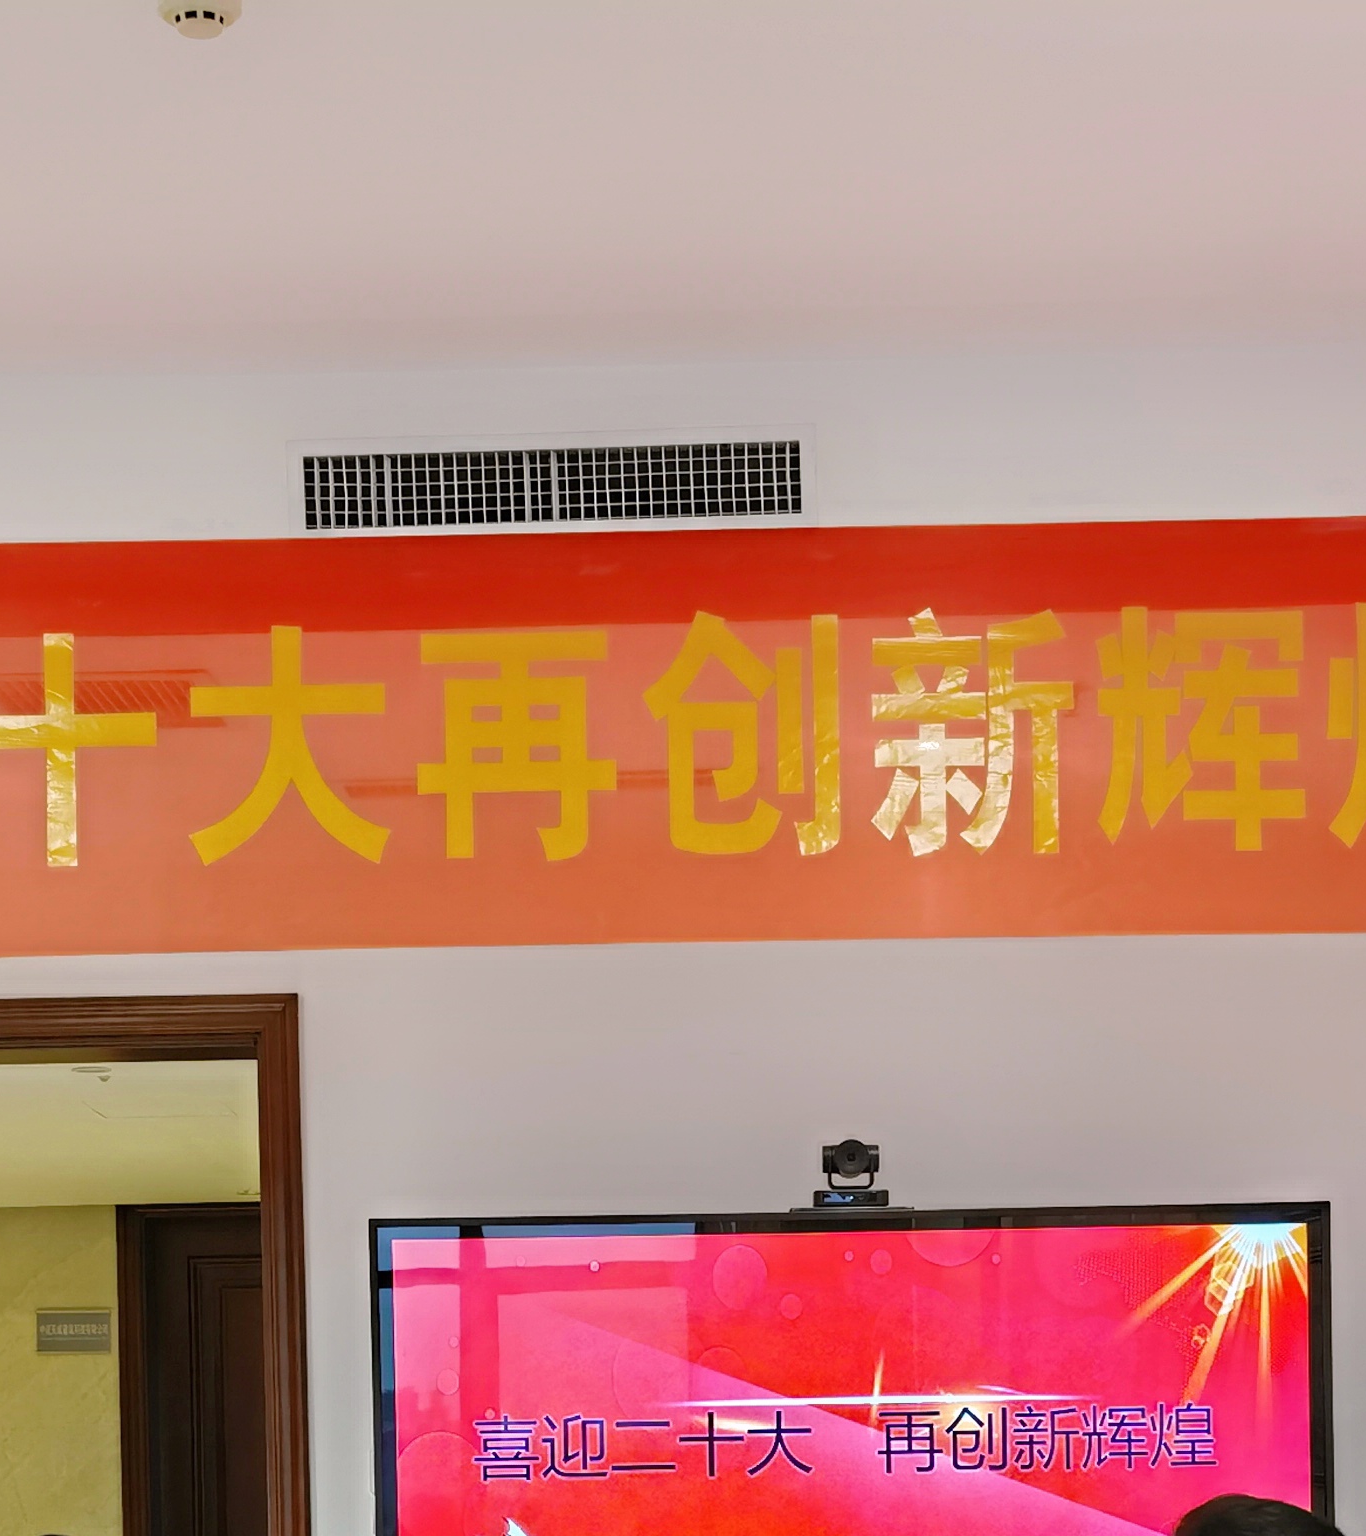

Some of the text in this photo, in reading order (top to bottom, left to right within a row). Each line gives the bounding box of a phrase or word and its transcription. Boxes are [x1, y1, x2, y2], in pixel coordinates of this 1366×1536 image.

[473, 1401, 1219, 1484] 喜迎二十大 再创新辉煌
